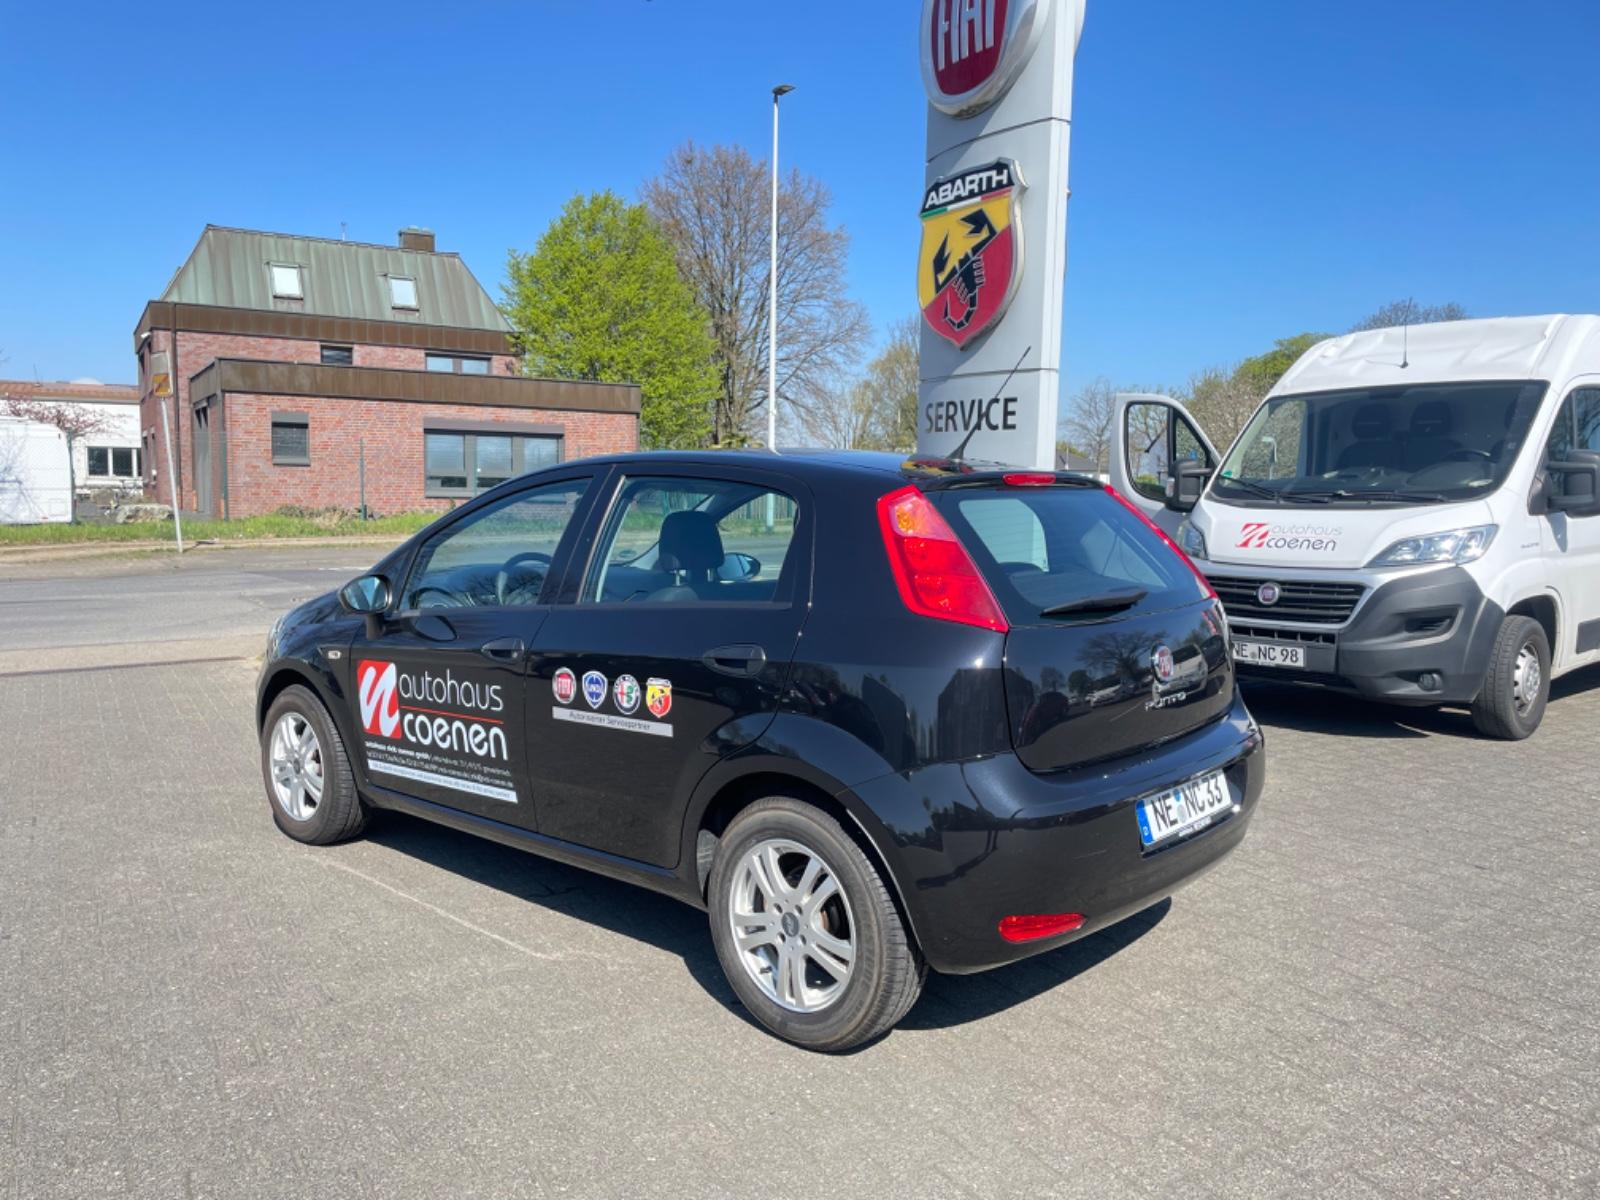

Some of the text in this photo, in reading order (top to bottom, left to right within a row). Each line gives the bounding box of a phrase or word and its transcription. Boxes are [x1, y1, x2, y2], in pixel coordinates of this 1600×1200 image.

[925, 169, 1008, 209] ABARTH
[925, 397, 1018, 433] SERVICE
[1266, 538, 1337, 551] coenen
[1258, 645, 1277, 661] NC
[1280, 648, 1299, 663] 98
[400, 668, 503, 712] autohaus
[403, 713, 508, 761] coenen
[1151, 793, 1179, 832] NE
[1181, 780, 1206, 818] NC
[1201, 773, 1223, 808] 33
